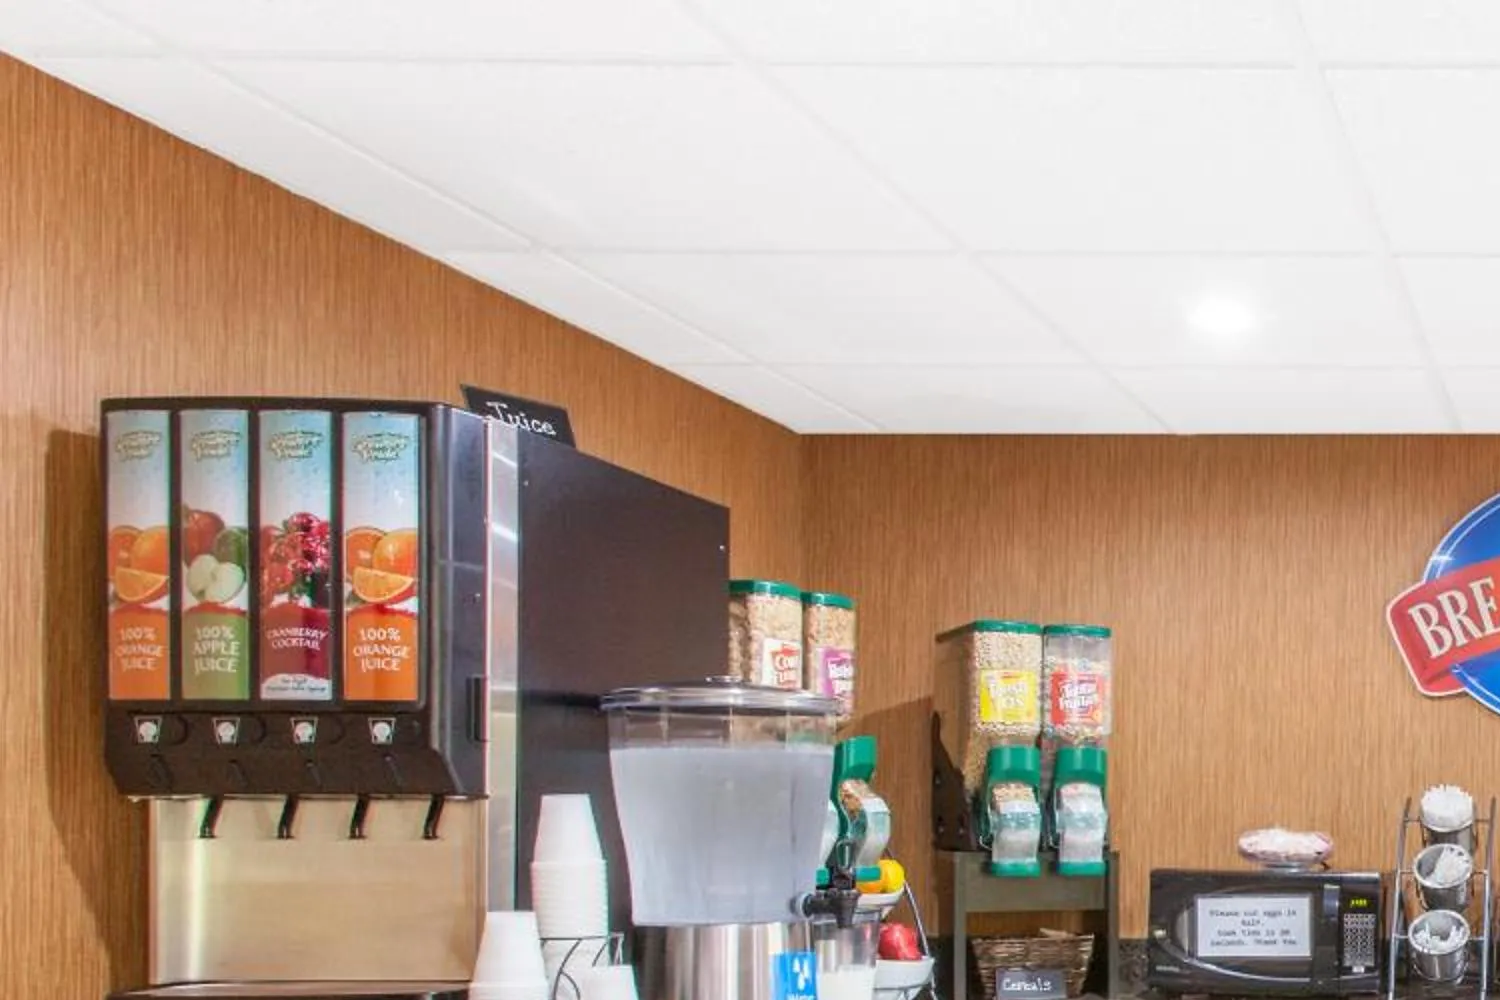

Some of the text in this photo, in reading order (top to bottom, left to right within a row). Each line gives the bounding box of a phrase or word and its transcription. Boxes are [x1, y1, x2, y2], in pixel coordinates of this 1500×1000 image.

[196, 625, 235, 640] 100%
[266, 627, 328, 642] CRANBERRY
[359, 627, 401, 641] 100%
[192, 640, 240, 656] APPLE
[271, 637, 321, 650] COCKTAIL
[353, 643, 411, 659] ORANGE
[121, 657, 157, 672] JUICE
[193, 657, 238, 676] JUICE
[360, 658, 401, 673] JUICE
[1002, 977, 1051, 991] Cereals
